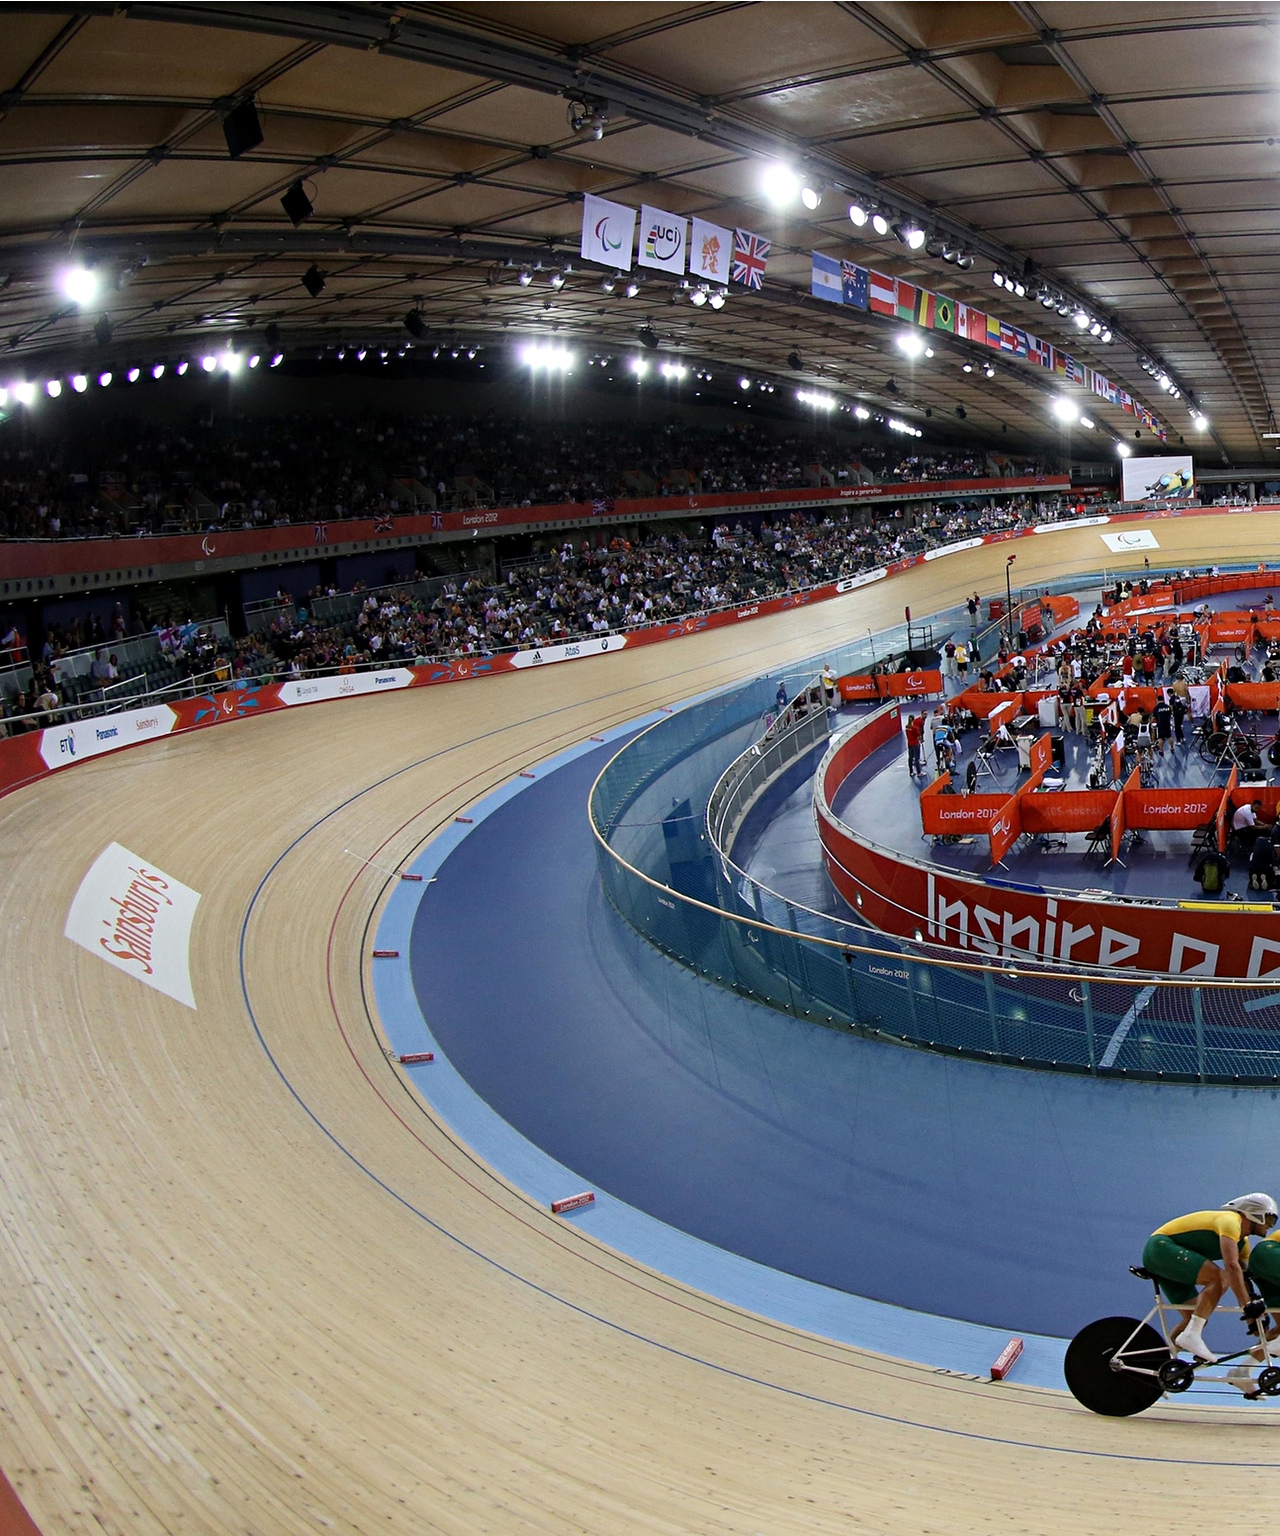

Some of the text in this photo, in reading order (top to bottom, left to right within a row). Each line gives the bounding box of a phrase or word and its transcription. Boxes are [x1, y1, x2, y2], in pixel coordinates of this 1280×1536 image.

[463, 512, 498, 525] London 2012
[375, 676, 396, 684] Panasonic
[96, 726, 118, 741] Panasonic
[60, 738, 68, 753] BT
[940, 808, 999, 819] London 2012
[1144, 803, 1208, 814] London 2012
[100, 866, 173, 975] Sainsbury's
[927, 872, 1141, 968] Inspire
[869, 965, 893, 977] London
